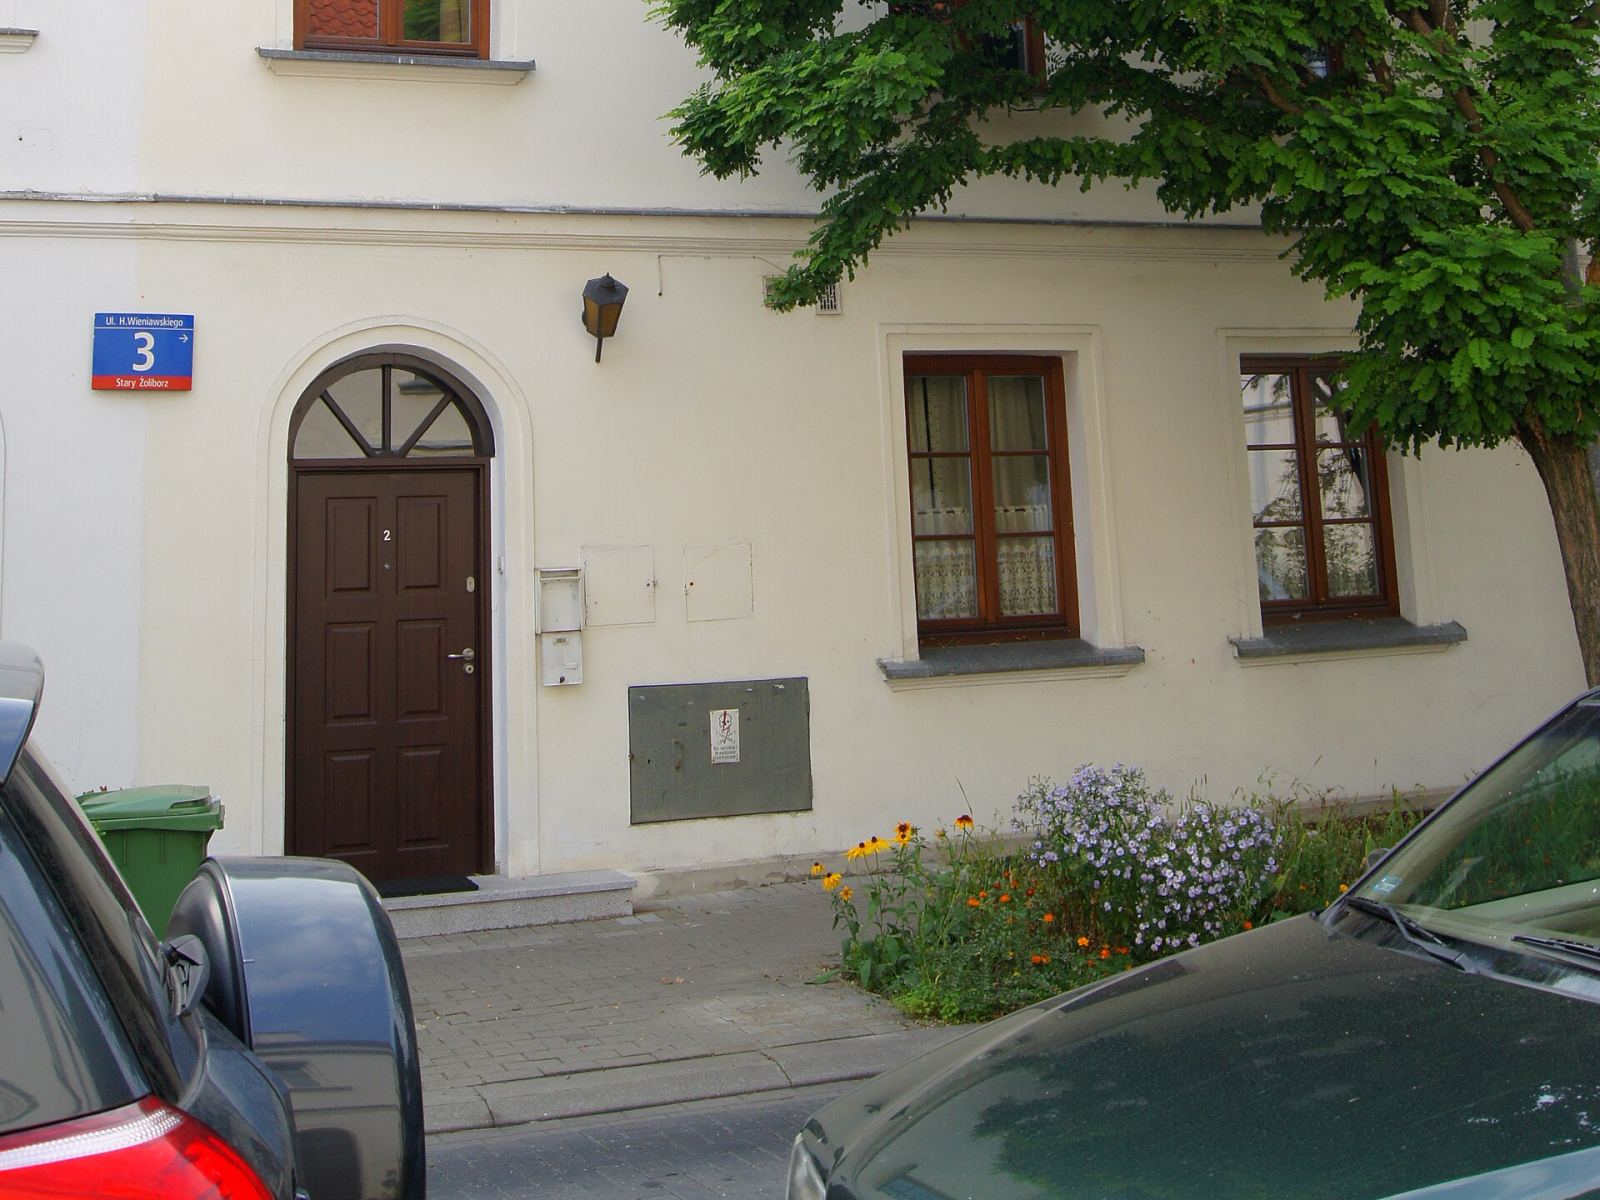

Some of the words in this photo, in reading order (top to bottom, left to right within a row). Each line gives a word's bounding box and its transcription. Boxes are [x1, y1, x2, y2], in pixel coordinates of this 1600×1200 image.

[105, 316, 115, 326] Ul.
[119, 316, 184, 328] H.Wieniawskiego
[132, 331, 155, 372] 3
[116, 378, 136, 389] Stary
[139, 376, 169, 388] Żoliborz
[383, 529, 391, 541] 2
